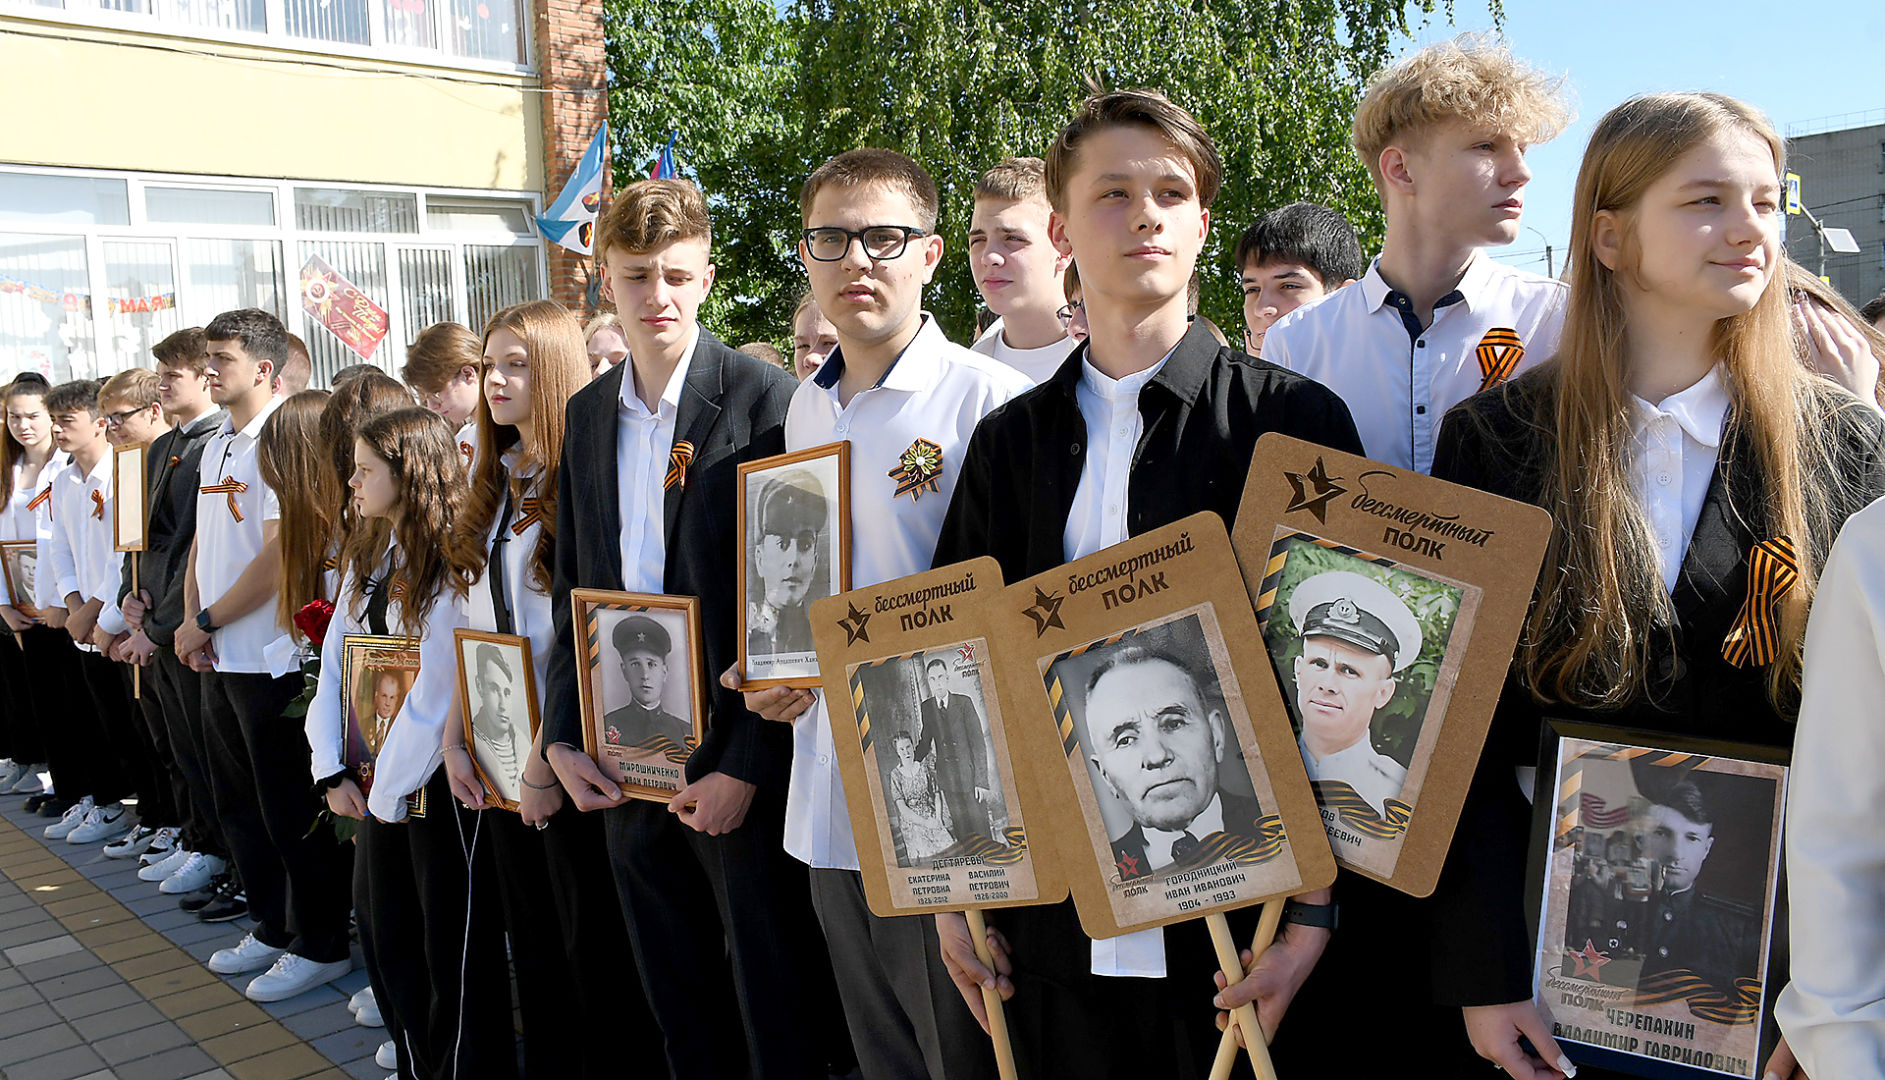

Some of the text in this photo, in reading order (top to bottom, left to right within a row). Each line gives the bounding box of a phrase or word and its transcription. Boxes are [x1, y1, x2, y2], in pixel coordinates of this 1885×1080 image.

[120, 295, 165, 313] МАЯ
[1351, 470, 1495, 547] бессмертный
[1383, 526, 1446, 560] ПОЛК
[1068, 531, 1195, 594] бессмертный
[874, 572, 977, 613] бессмертный
[1101, 571, 1170, 610] ПОЛК
[900, 604, 954, 632] ПОЛК
[618, 761, 680, 779] МИРОШНИЧЕНКО
[933, 856, 985, 871] ДЕГТЯРЕВЫ
[968, 867, 1006, 880] ВАСИЛИЙ
[1165, 859, 1237, 886] ГОРОДНИЦКИЙ
[908, 873, 951, 885] ЕКАТЕРИНА
[912, 884, 951, 895] ПЕТРОВНА
[969, 880, 1010, 891] ПЕТРОВИЧ
[1165, 873, 1246, 900] ИВАН ИВАНОВИЧ
[1123, 885, 1149, 898] ПОЛК
[1178, 899, 1201, 911] 1904
[1213, 890, 1236, 903] 1993
[1560, 992, 1605, 1012] ПОЛК
[1606, 1007, 1695, 1040] ЧЕРЕПАХИН
[1553, 1021, 1748, 1075] ВЛАДИМИР ГАВРИЛОВИЧ
